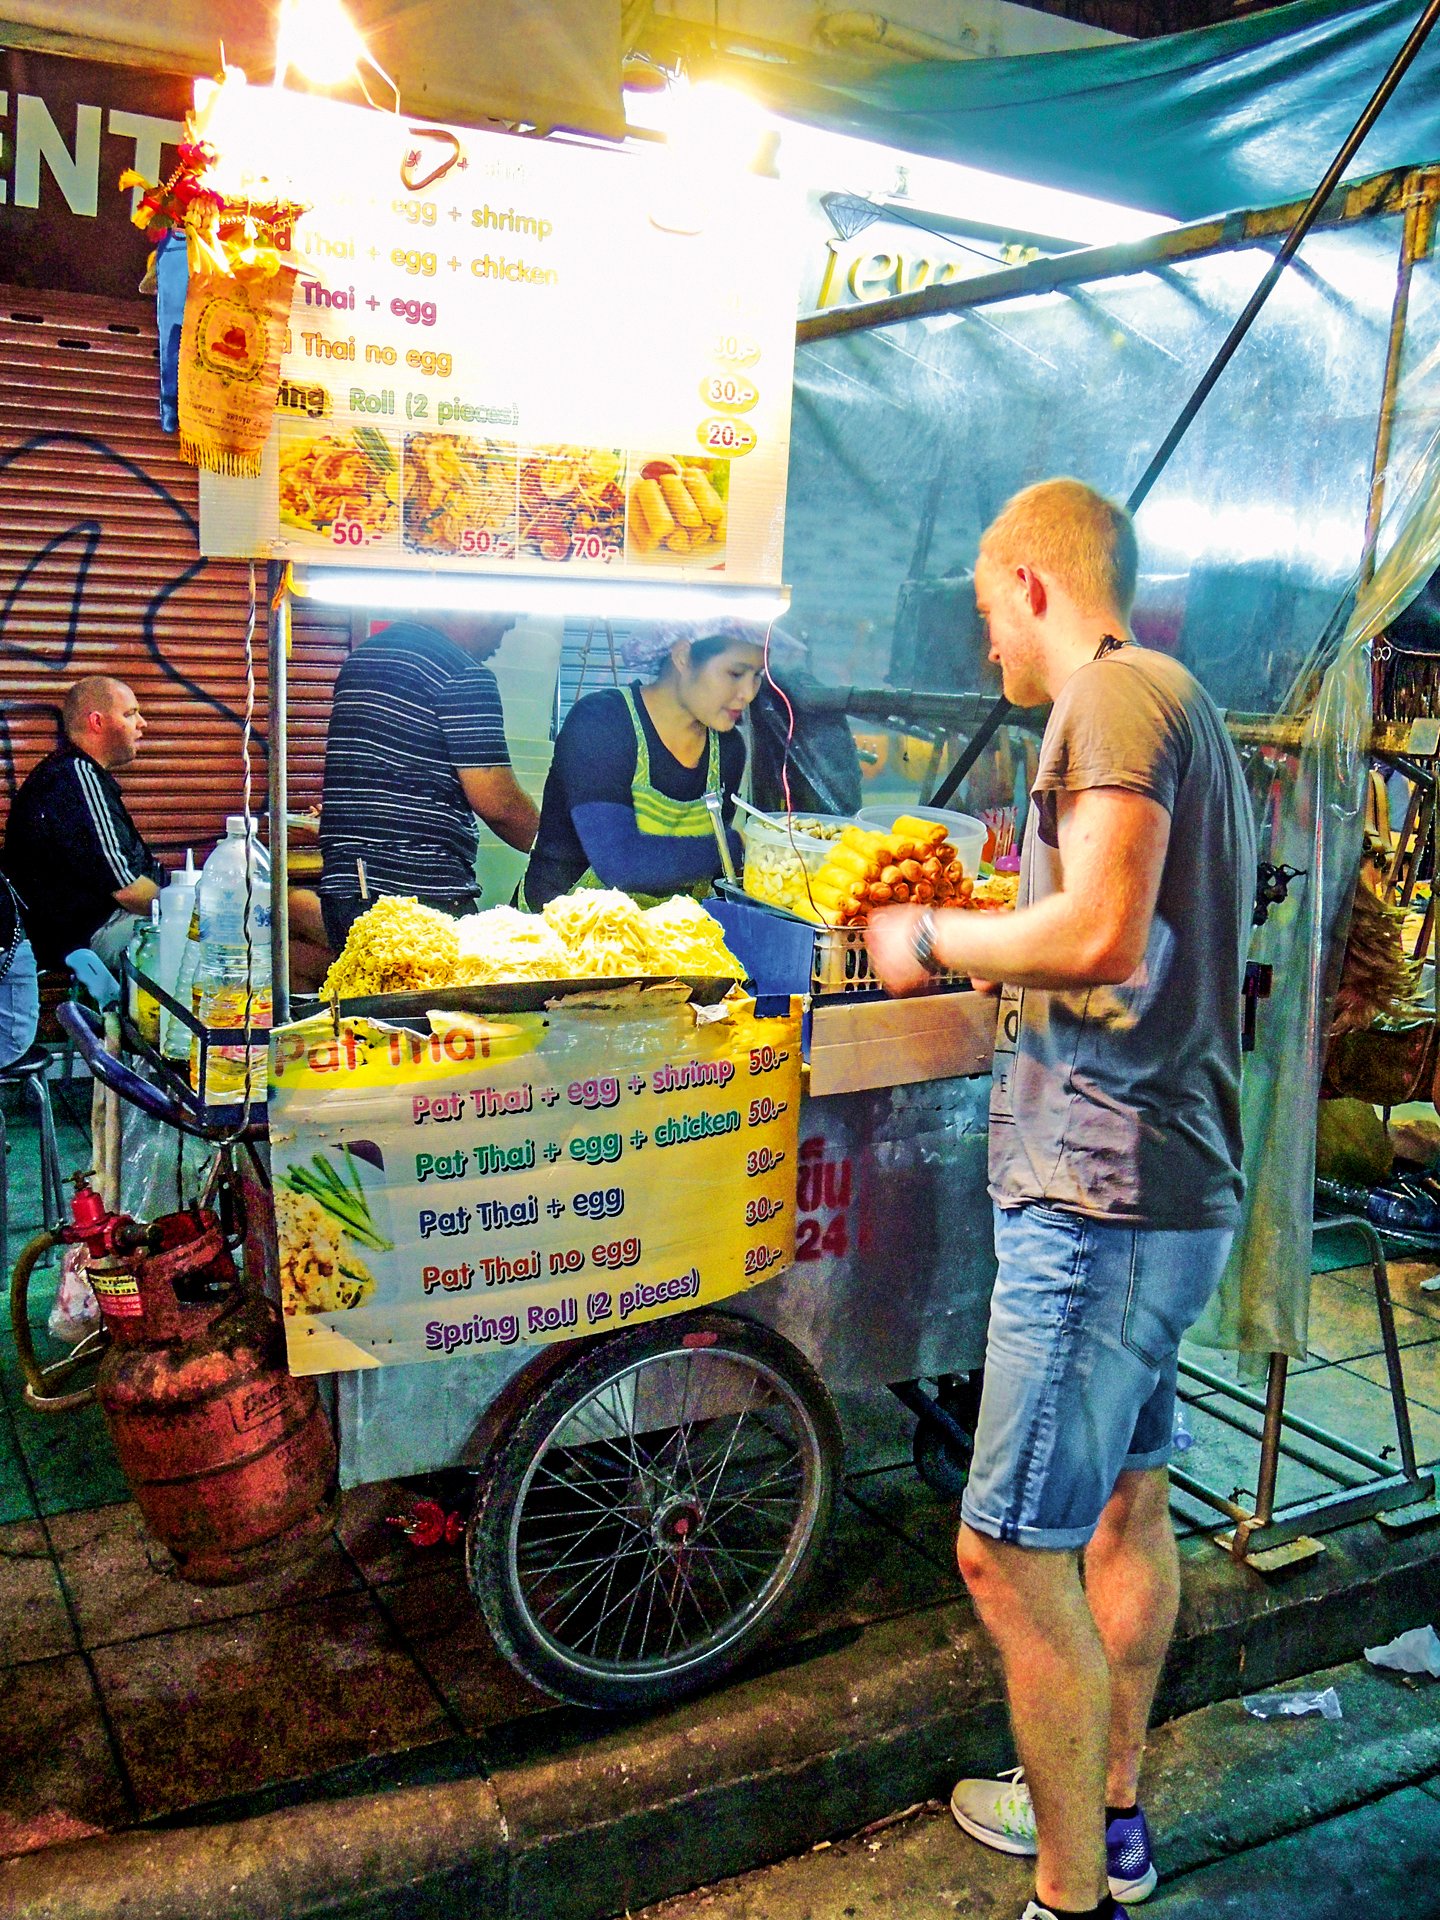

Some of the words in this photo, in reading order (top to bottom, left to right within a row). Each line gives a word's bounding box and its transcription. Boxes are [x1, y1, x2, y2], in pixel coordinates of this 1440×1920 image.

[0, 90, 185, 222] NT
[390, 199, 437, 227] egg
[471, 204, 553, 241] shrimp
[390, 248, 437, 276] egg
[471, 254, 559, 285] chicken
[300, 281, 355, 310] Thai
[366, 295, 380, 311] +
[390, 298, 437, 326] egg
[301, 332, 355, 361] Thai
[366, 344, 397, 365] no
[406, 349, 453, 377] egg
[350, 387, 395, 415] Roll
[405, 392, 429, 420] (2
[438, 397, 520, 426] pieces)
[711, 379, 752, 401] 30.-
[709, 424, 750, 447] 20.-
[332, 521, 382, 546] 50.-
[461, 530, 509, 554] 50.-
[572, 536, 618, 560] 70.-
[274, 1028, 358, 1077] Pat
[412, 1092, 465, 1124] Pat
[470, 1082, 533, 1118] Thai
[541, 1087, 559, 1107] +
[567, 1075, 620, 1108] egg
[628, 1075, 646, 1095] +
[652, 1058, 735, 1095] shrimp
[749, 1045, 788, 1075] 50.-
[415, 1150, 468, 1182] Pat
[473, 1139, 535, 1175] Thai
[543, 1142, 561, 1162] +
[569, 1130, 622, 1164] egg
[630, 1129, 647, 1149] +
[654, 1109, 740, 1147] chicken
[748, 1096, 788, 1127] 50.-
[419, 1206, 471, 1239] Pat
[476, 1195, 538, 1231] Thai
[546, 1198, 565, 1218] +
[573, 1187, 624, 1222] egg
[746, 1147, 785, 1176] 30.-
[422, 1262, 475, 1294] Pat
[479, 1250, 541, 1286] Thai
[549, 1249, 585, 1275] no
[591, 1237, 641, 1270] egg
[745, 1196, 783, 1226] 30.-
[425, 1314, 520, 1353] Spring
[527, 1298, 577, 1333] Roll
[586, 1290, 612, 1323] (2
[619, 1268, 700, 1320] pieces)
[744, 1245, 782, 1277] 20.-
